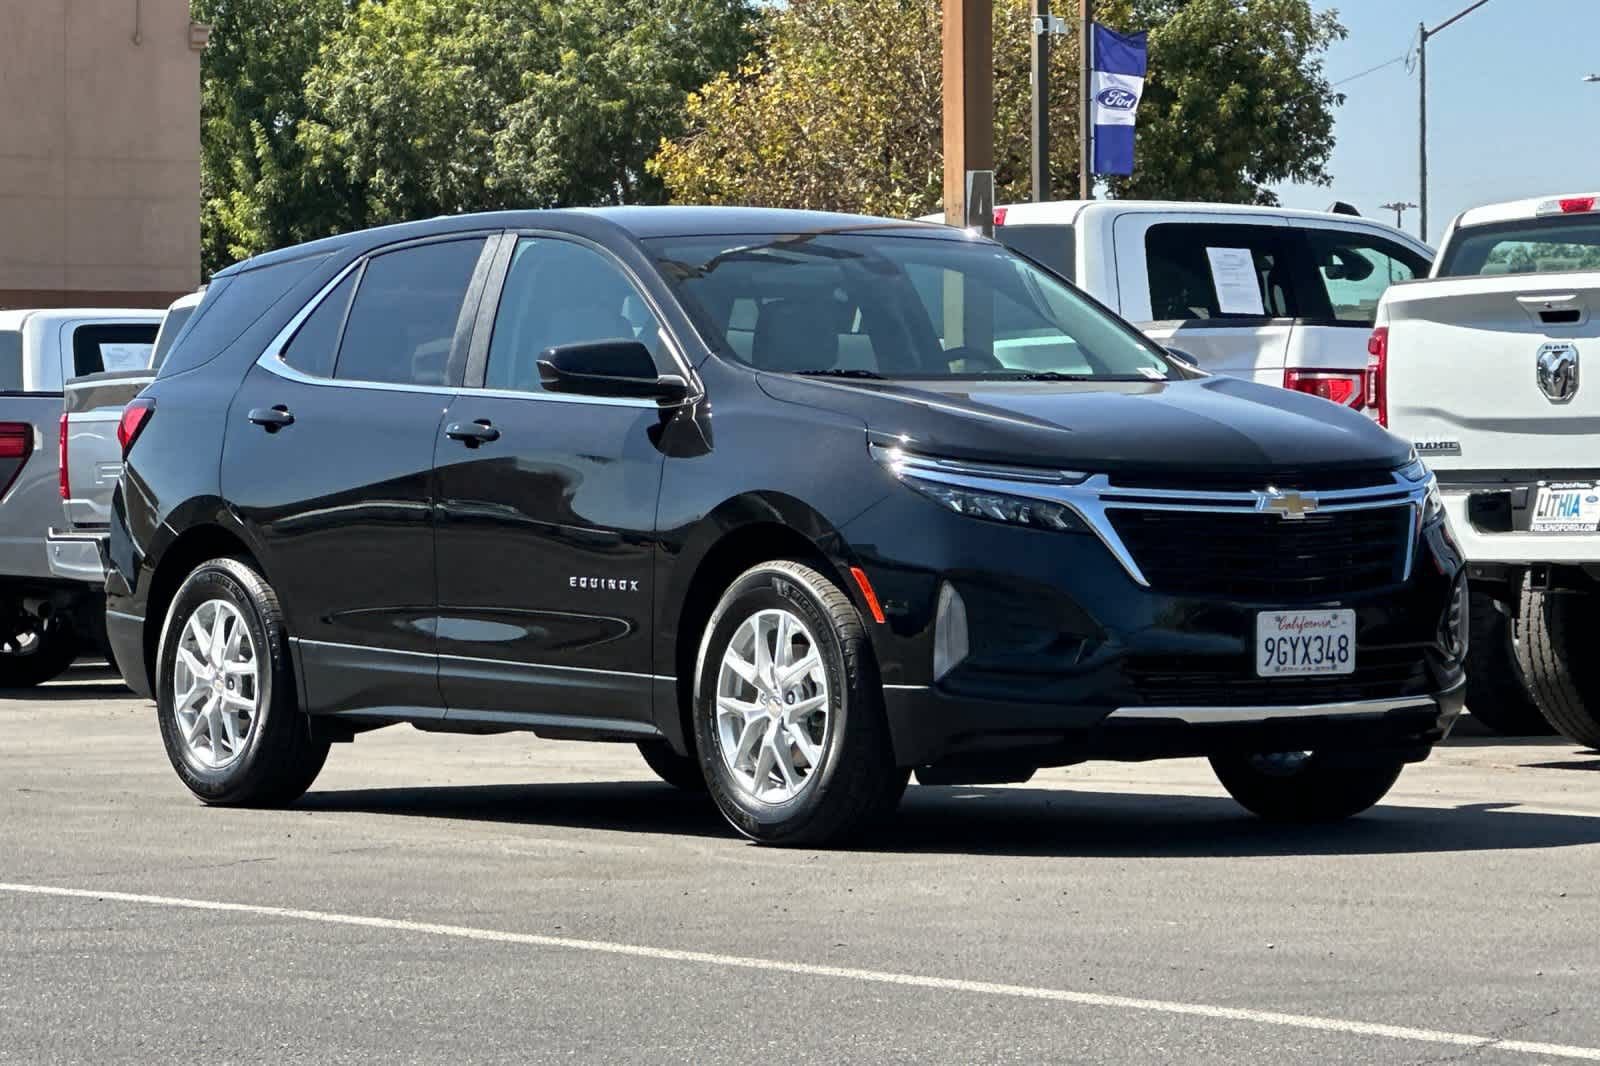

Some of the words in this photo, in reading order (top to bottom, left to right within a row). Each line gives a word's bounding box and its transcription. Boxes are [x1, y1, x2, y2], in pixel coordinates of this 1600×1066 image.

[1105, 90, 1135, 108] Ford
[1537, 493, 1581, 517] LITHIA
[569, 576, 640, 591] EQUINOX
[1278, 614, 1331, 634] California
[1264, 634, 1349, 667] 9GYX348
